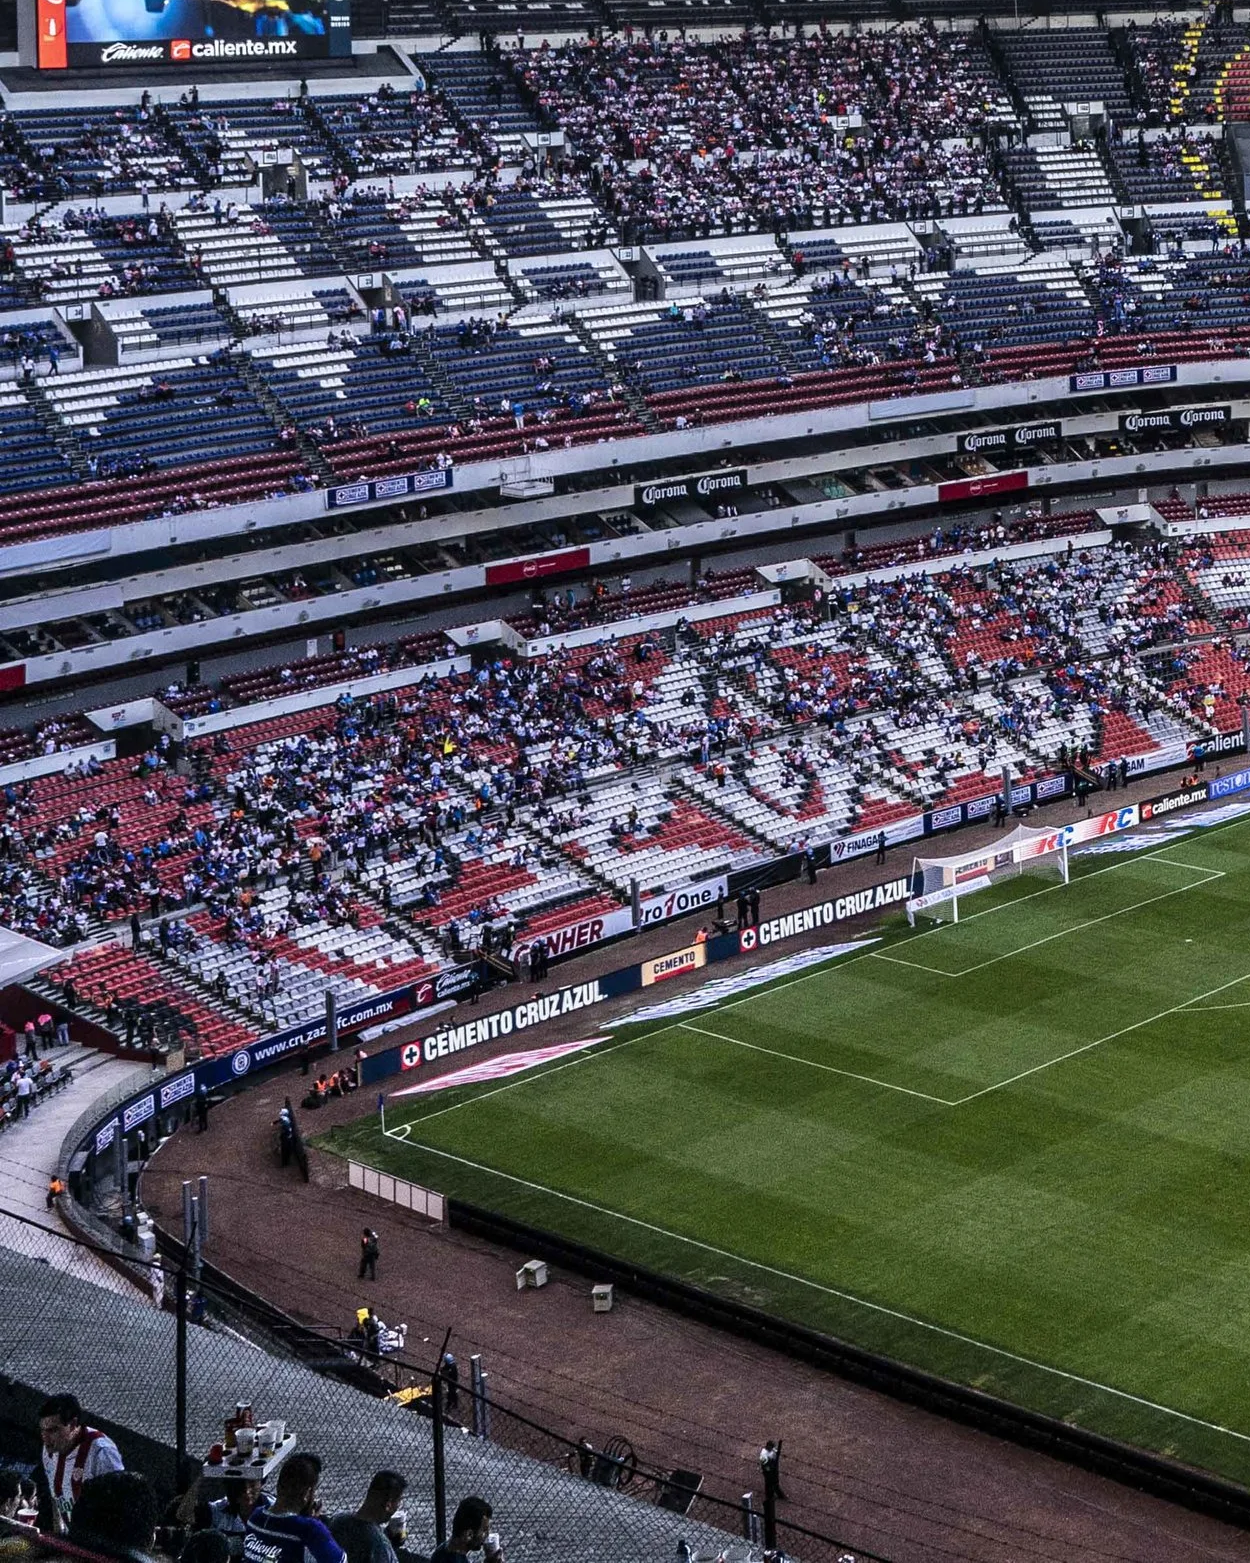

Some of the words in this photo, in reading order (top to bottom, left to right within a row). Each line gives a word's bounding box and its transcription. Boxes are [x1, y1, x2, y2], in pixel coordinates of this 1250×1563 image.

[192, 39, 297, 57] caliente.mx
[1125, 414, 1170, 432] Corona
[1180, 410, 1225, 428] Corona
[964, 434, 1006, 452] Corona
[1015, 427, 1056, 444] Corona
[642, 484, 688, 505] Corona
[697, 475, 741, 495] Corona
[1152, 788, 1207, 814] caliente.mx
[1100, 807, 1133, 834] RC
[759, 902, 834, 945] CEMENTO
[835, 889, 874, 920] CRUZ
[513, 919, 604, 967] CNHER
[653, 950, 696, 974] CEMENTO
[254, 1000, 393, 1061] www.crzazfc.com.mx
[424, 1010, 513, 1061] CEMENTO
[515, 997, 561, 1029] CRUZ
